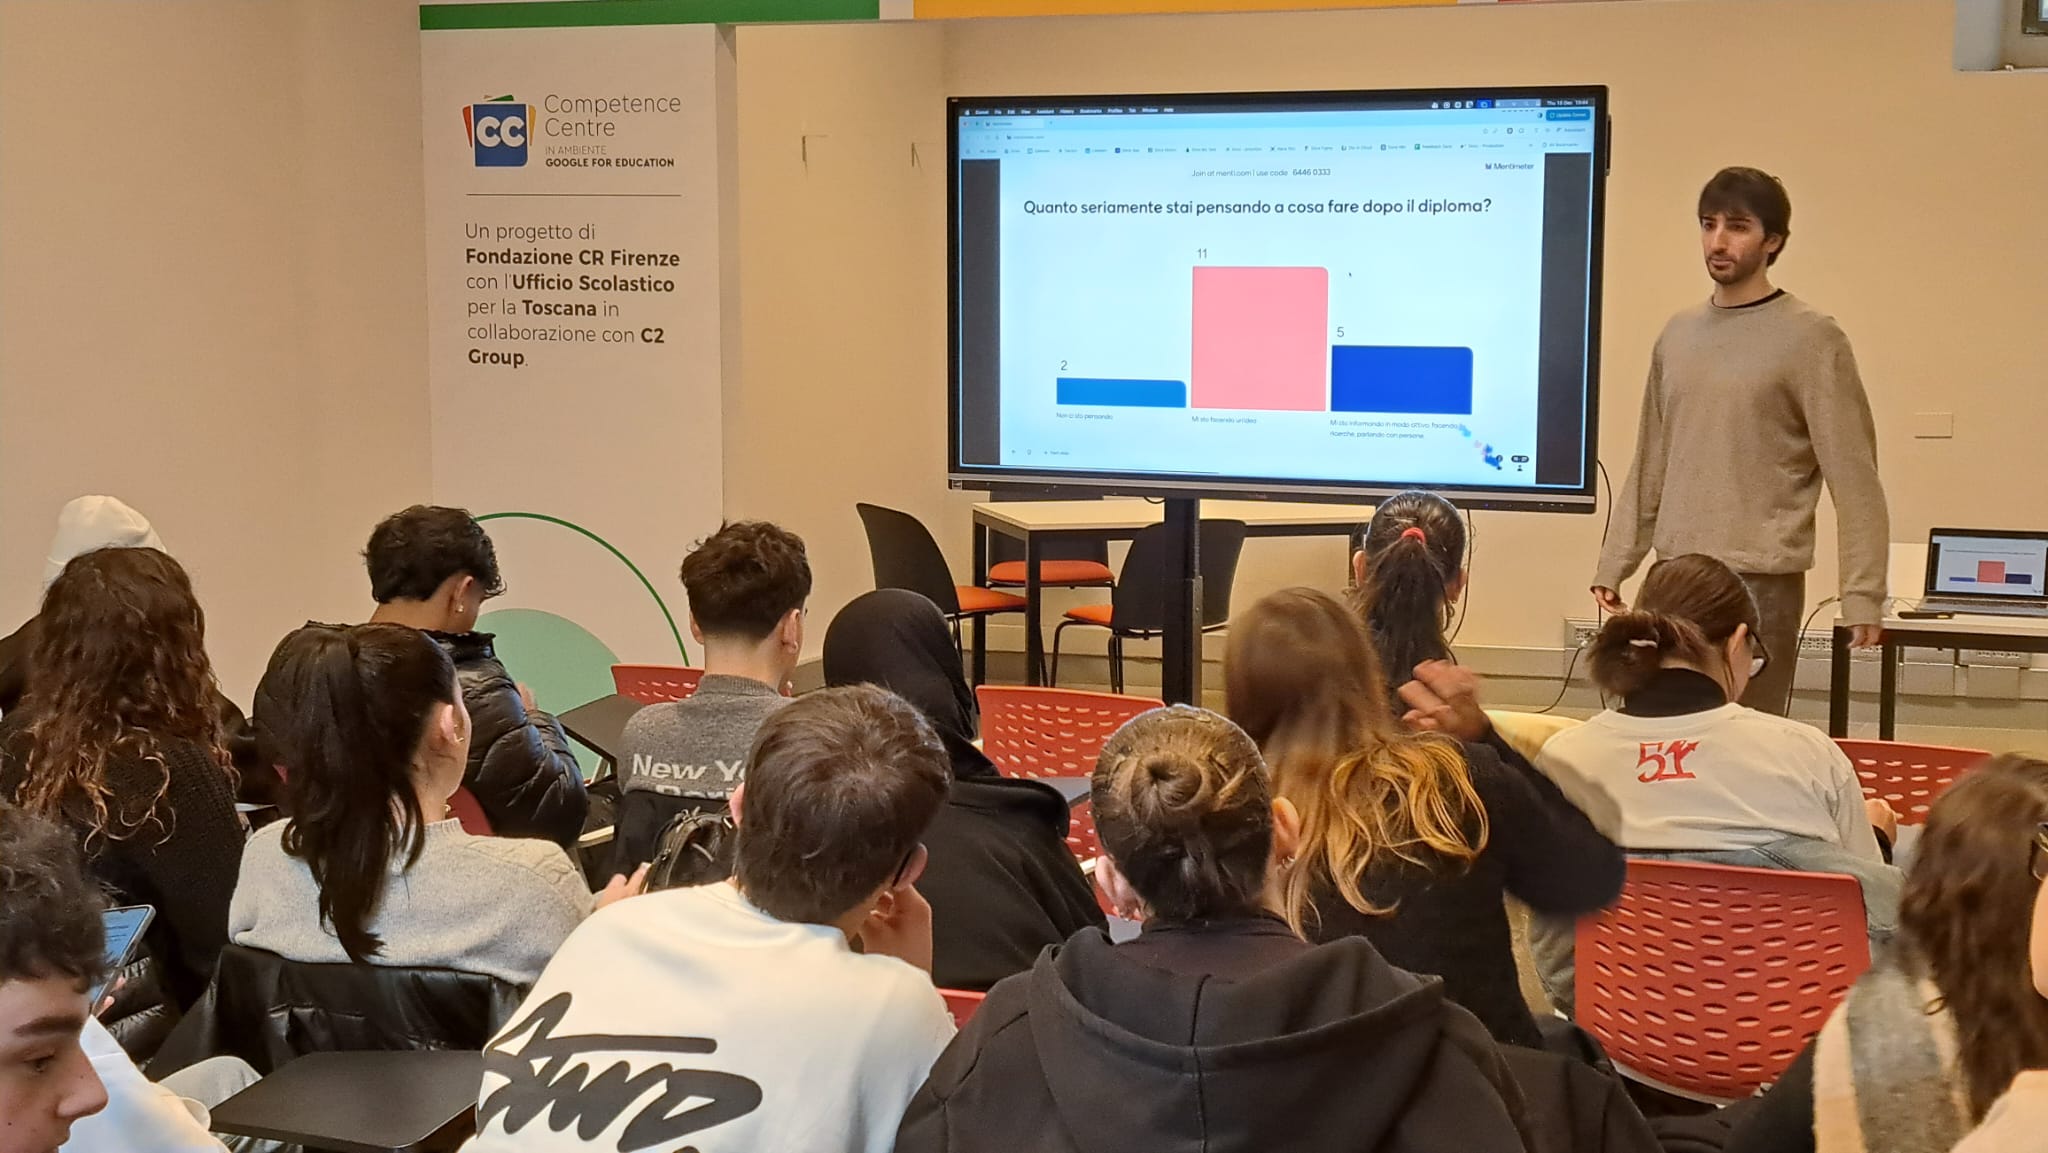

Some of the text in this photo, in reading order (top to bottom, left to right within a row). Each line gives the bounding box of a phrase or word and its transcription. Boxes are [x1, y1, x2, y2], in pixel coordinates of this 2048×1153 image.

[544, 94, 681, 117] Competence
[475, 116, 525, 147] CC
[544, 117, 615, 137] Centre
[545, 145, 607, 156] IN AMBIENTE
[545, 158, 674, 168] GOOGLE FOR EDUCATION
[1493, 162, 1534, 170] Mentimeter
[1192, 169, 1206, 177] Join
[1270, 169, 1288, 177] code
[1023, 198, 1492, 216] Quanto seriamente stai pensando a cosa fare dopo il diploma?
[465, 223, 596, 243] Un progetto di
[465, 248, 680, 267] Fondazione CR Firenze
[1197, 248, 1208, 259] 11
[466, 277, 498, 289] con
[579, 274, 675, 292] Scolastico
[468, 299, 619, 318] per la Toscana in
[467, 323, 665, 344] collaborazione con C2
[1337, 327, 1345, 337] 5
[468, 349, 529, 369] Group.
[1060, 360, 1068, 371] 2
[1349, 420, 1384, 428] informando
[632, 753, 707, 780] New
